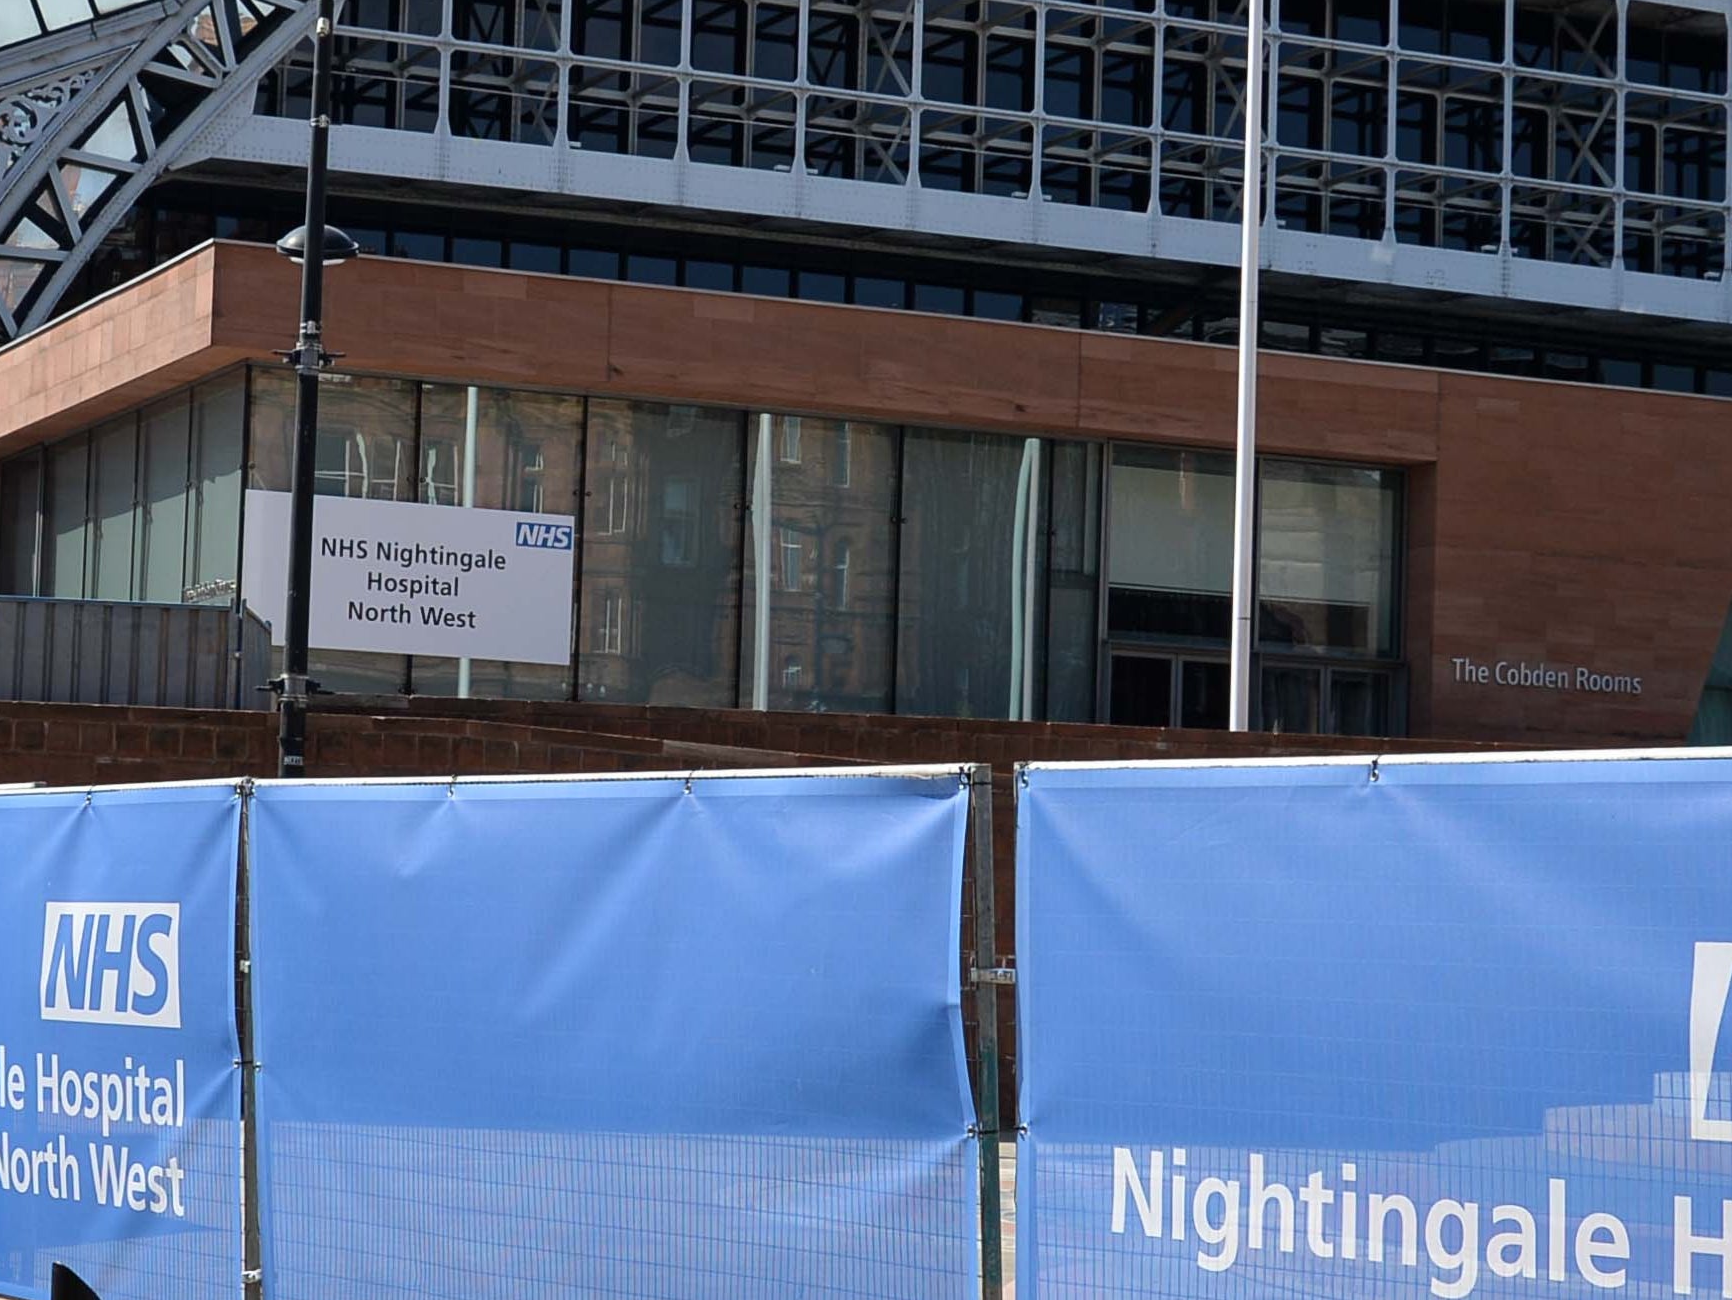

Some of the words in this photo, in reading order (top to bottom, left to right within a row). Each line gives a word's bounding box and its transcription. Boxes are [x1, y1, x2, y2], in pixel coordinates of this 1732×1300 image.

[321, 536, 369, 560] NHS
[375, 541, 507, 572] Nightingale
[518, 523, 570, 548] NHS
[367, 572, 460, 598] Hospital
[348, 600, 412, 625] North
[420, 605, 477, 630] West
[1452, 657, 1489, 684] The
[1495, 661, 1569, 689] Cobden
[1575, 666, 1642, 695] Rooms
[44, 911, 174, 1016] NHS
[35, 1051, 186, 1138] Hospital
[88, 1142, 185, 1217] West
[1108, 1145, 1632, 1300] Nightingale
